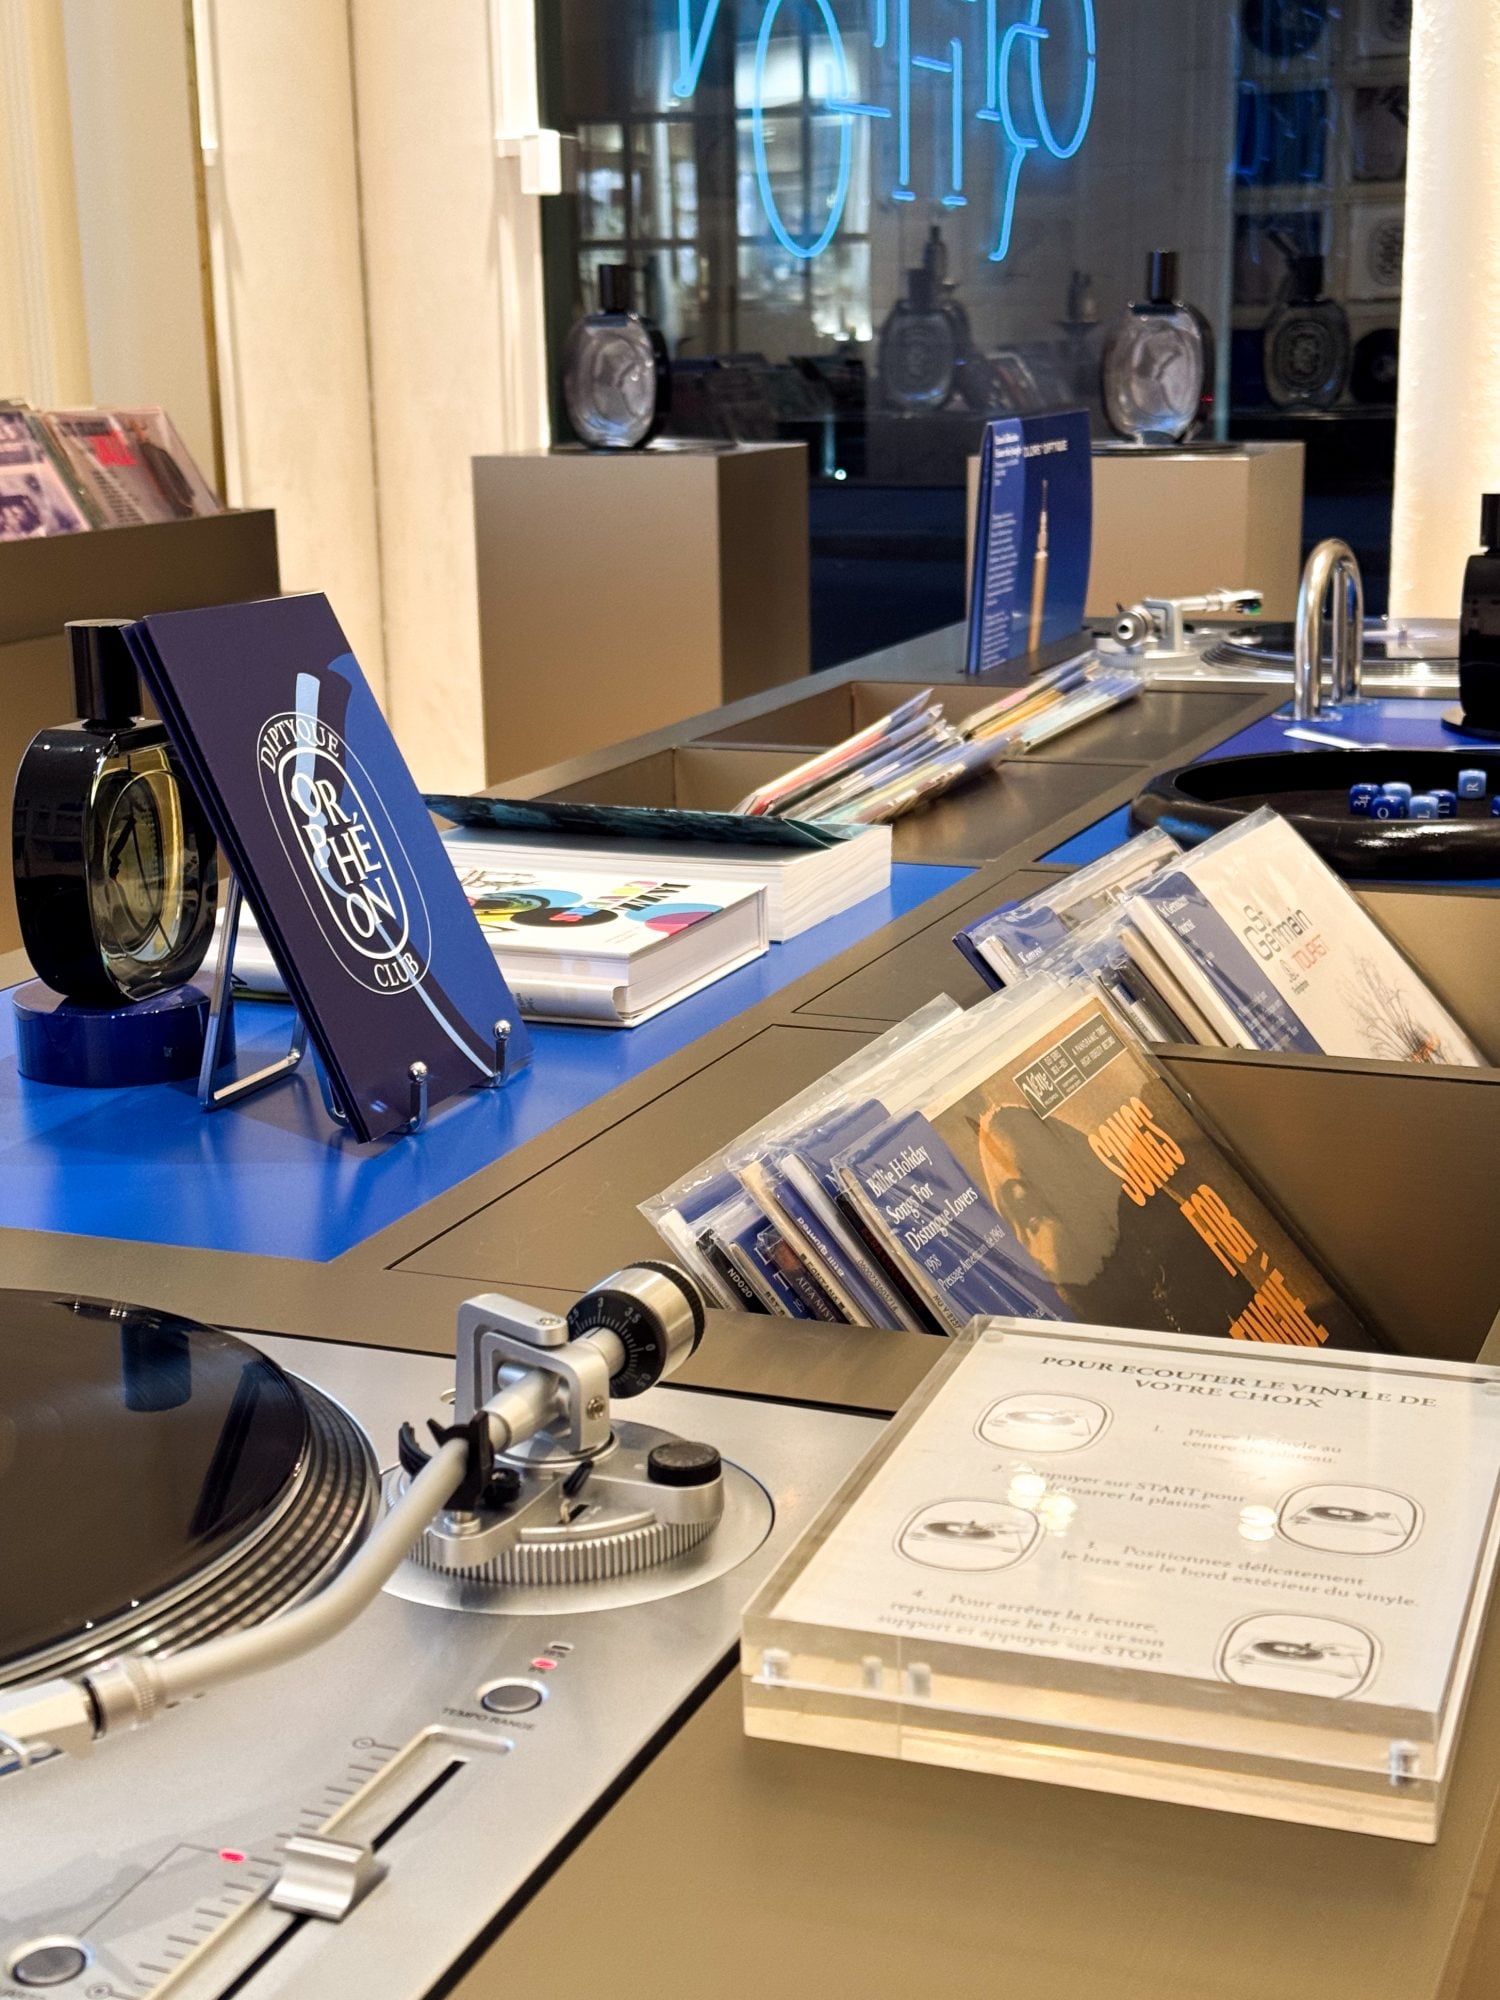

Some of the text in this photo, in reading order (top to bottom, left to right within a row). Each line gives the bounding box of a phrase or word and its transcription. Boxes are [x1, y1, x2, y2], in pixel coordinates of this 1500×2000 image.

[261, 717, 339, 774] DIPTYQUE
[1242, 904, 1313, 961] St Germain
[373, 952, 420, 988] CLUB
[1088, 1096, 1186, 1207] SONGS
[866, 1164, 897, 1198] Billie
[890, 1145, 933, 1185] Holiday
[886, 1181, 934, 1225] Songs For
[949, 1185, 979, 1218] Lovers
[1179, 1183, 1259, 1278] FOR
[727, 1267, 754, 1299] ND020
[794, 1274, 817, 1300] ALFA
[597, 1297, 604, 1308] 3
[624, 1306, 642, 1324] 3.5
[645, 1343, 656, 1352] 0
[1041, 1356, 1438, 1408] POUR ECOUTER LE VINYLE DE
[1134, 1379, 1325, 1409] VOTRE CHOIX
[1181, 1440, 1237, 1452] centre
[1320, 1445, 1343, 1454] au
[1104, 1478, 1131, 1489] sur
[1136, 1480, 1201, 1497] START
[1202, 1489, 1247, 1504] pour
[1130, 1492, 1144, 1503] la
[1060, 1551, 1420, 1608] le bras sur le bord extérieur du vinyle.
[1123, 1545, 1233, 1569] Positionnez
[1237, 1561, 1366, 1586] délicatement
[949, 1593, 993, 1609] Pour
[1065, 1609, 1083, 1622] la
[442, 1707, 535, 1731] TEMPO RANGE
